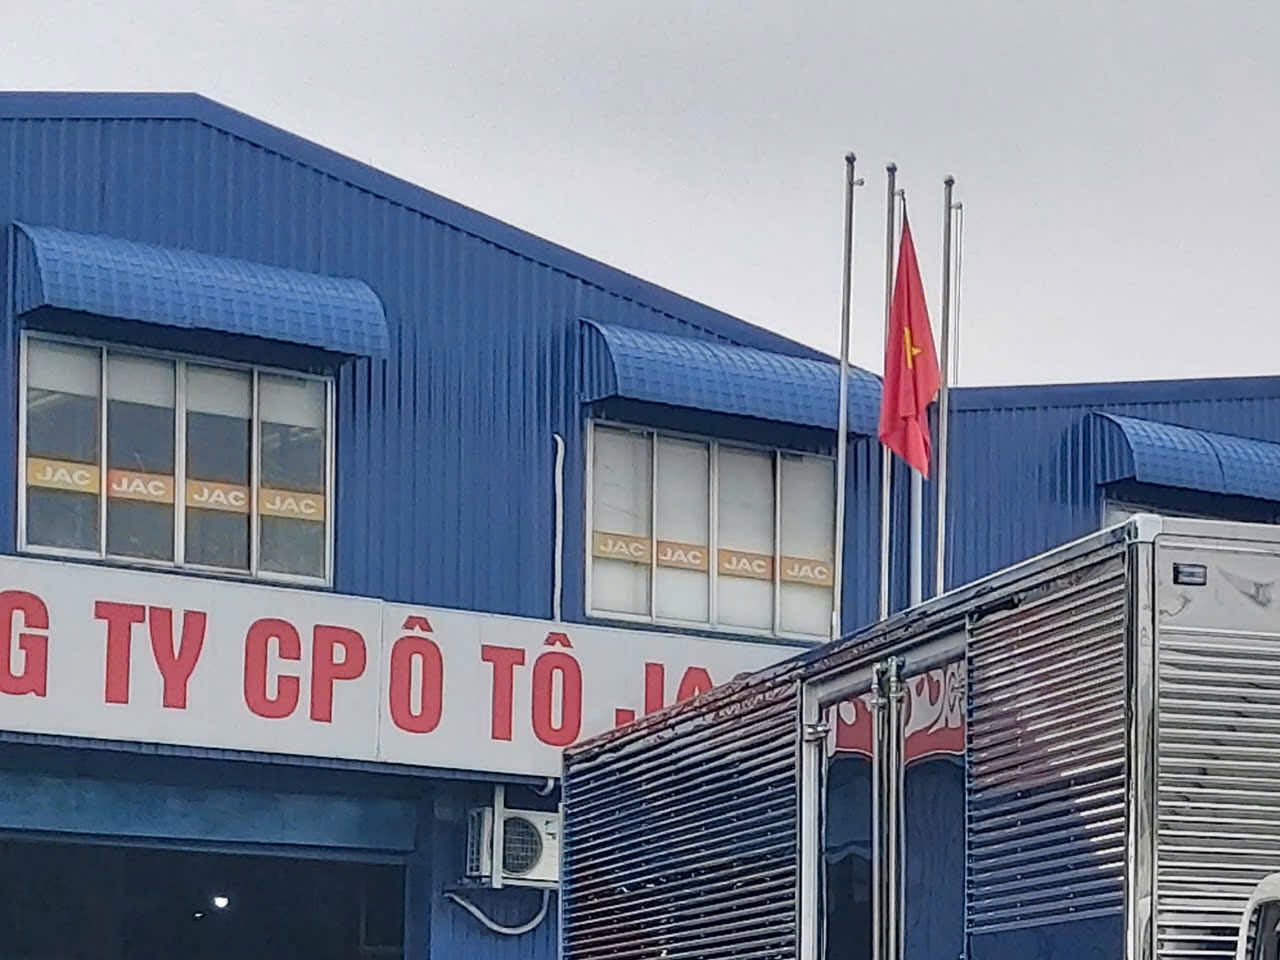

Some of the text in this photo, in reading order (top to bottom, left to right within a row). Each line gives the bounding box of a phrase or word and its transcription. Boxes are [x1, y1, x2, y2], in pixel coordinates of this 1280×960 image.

[36, 466, 92, 485] JAC
[112, 477, 167, 496] JAC
[193, 487, 246, 506] JAC
[265, 496, 318, 514] JAC
[600, 538, 645, 556] JAC
[659, 547, 703, 564] JAC
[723, 556, 767, 574] JAC
[787, 563, 828, 579] JAC
[94, 600, 207, 709] TY
[481, 631, 583, 747] TÔ
